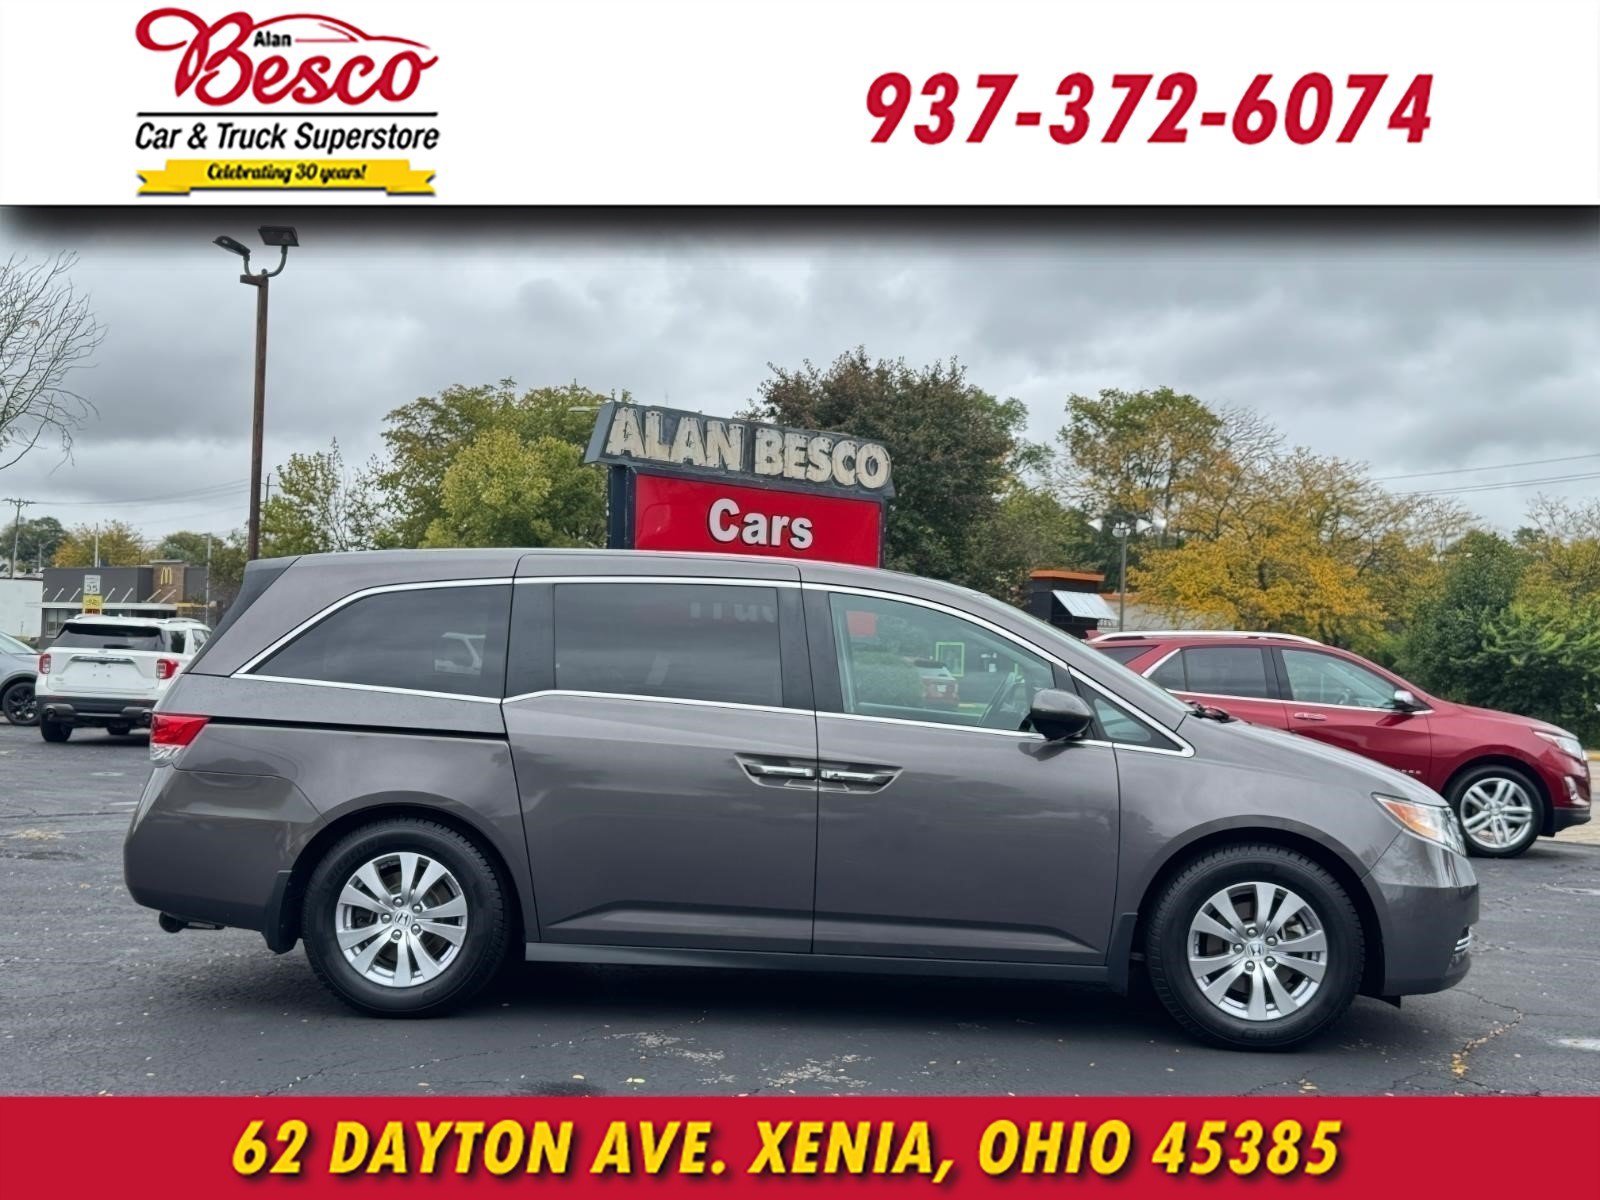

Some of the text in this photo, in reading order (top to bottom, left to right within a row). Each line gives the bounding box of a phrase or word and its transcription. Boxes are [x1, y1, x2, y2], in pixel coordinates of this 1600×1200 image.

[605, 406, 891, 489] ALAN BESCO
[708, 498, 813, 550] Cars
